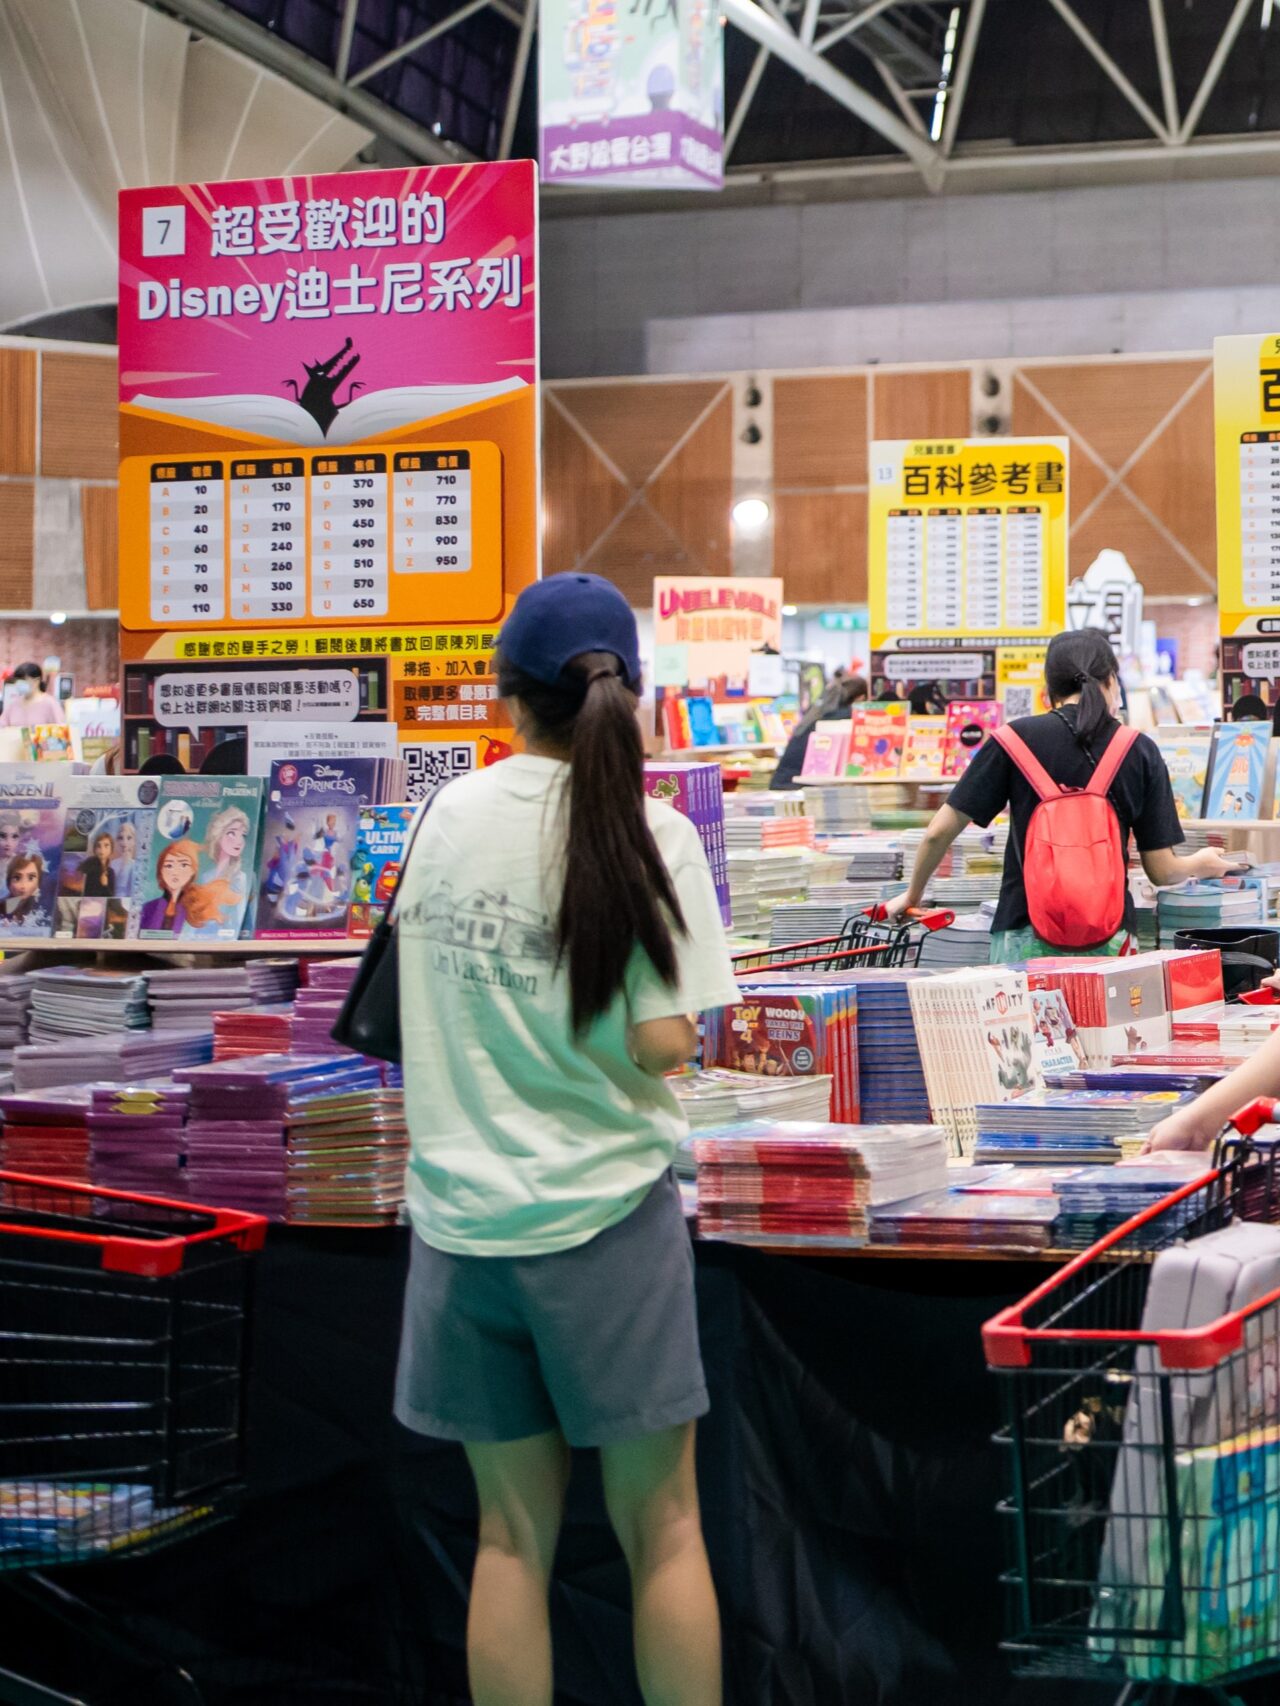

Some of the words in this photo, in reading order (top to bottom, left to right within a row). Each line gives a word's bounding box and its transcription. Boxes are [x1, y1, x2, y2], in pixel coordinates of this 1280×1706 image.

[210, 191, 446, 258] 超受歡迎的
[157, 220, 172, 245] 7
[138, 254, 522, 323] Disney迪士尼系列
[878, 467, 893, 480] 13
[437, 476, 456, 484] 710
[903, 461, 1064, 496] 百科參考書
[272, 483, 291, 491] 130
[353, 479, 373, 488] 370
[195, 485, 207, 494] 10
[353, 499, 373, 508] 390
[436, 496, 456, 505] 770
[194, 505, 207, 514] 20
[272, 503, 291, 511] 170
[353, 519, 374, 528] 450
[436, 516, 457, 525] 830
[194, 525, 208, 533] 40
[272, 522, 291, 531] 210
[353, 539, 374, 548] 490
[436, 536, 457, 545] 900
[194, 545, 208, 553] 60
[271, 542, 292, 551] 240
[354, 559, 373, 568] 510
[436, 556, 457, 565] 950
[195, 564, 207, 573] 70
[272, 562, 292, 571] 260
[195, 584, 208, 592] 90
[272, 582, 292, 591] 300
[354, 579, 374, 588] 570
[193, 604, 210, 612] 110
[272, 602, 292, 611] 330
[353, 599, 374, 608] 650
[404, 704, 488, 722] 及完整價目表
[313, 764, 344, 780] Disney
[0, 783, 43, 797] ROZEN
[298, 776, 356, 797] PRINCESS
[451, 950, 538, 995] Vacation
[732, 1006, 762, 1021] TOY
[765, 1007, 805, 1020] WOODY
[740, 1029, 752, 1044] 4
[768, 1028, 800, 1041] REINS
